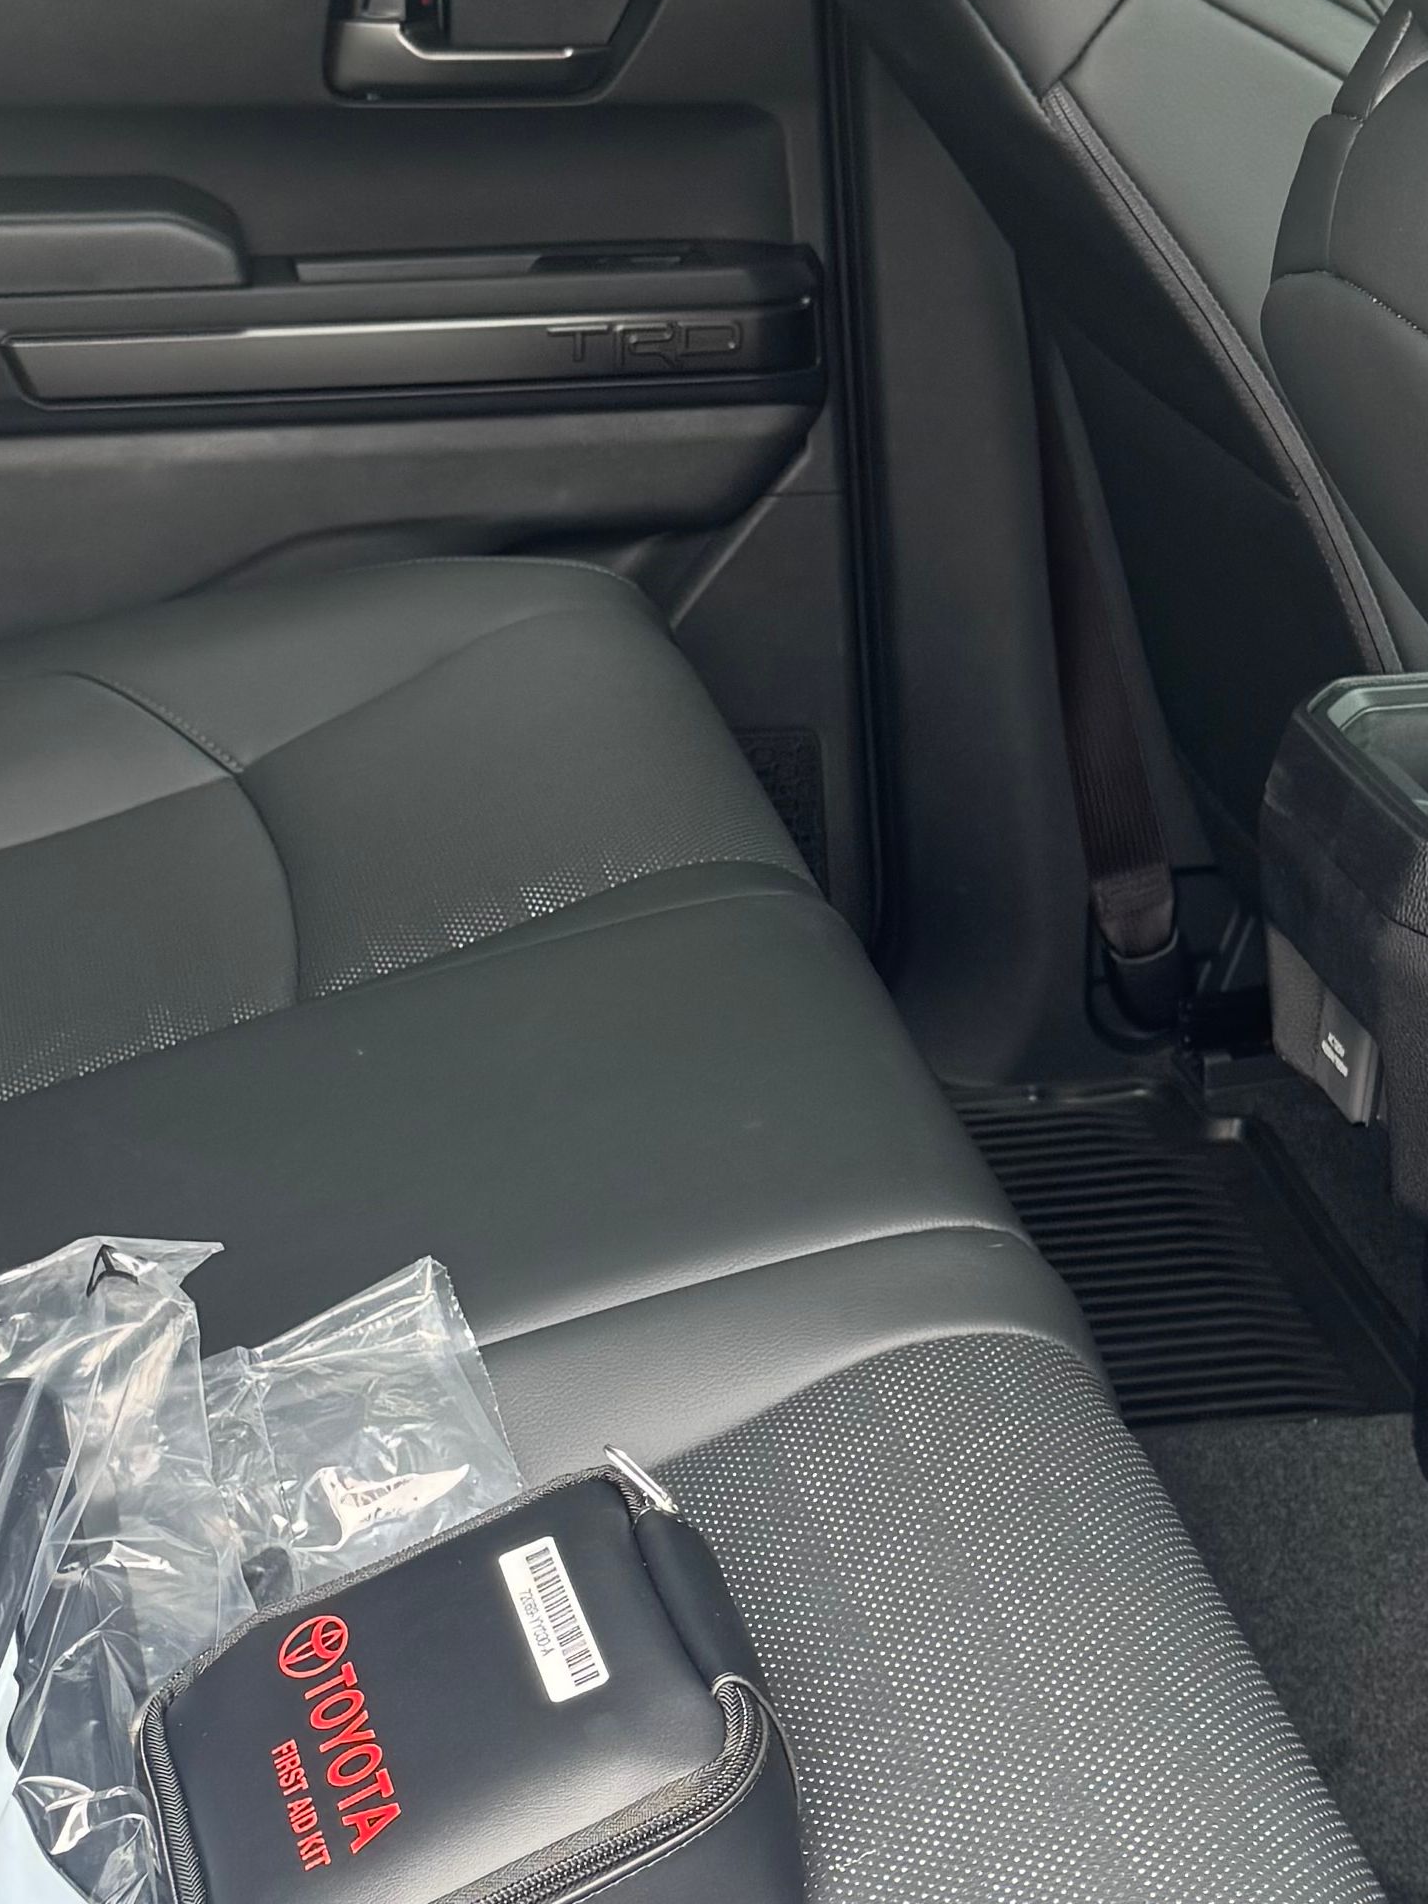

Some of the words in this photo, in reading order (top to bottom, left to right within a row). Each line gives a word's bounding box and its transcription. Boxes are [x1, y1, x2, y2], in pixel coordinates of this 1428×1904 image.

[547, 322, 743, 368] TRD
[271, 1739, 309, 1796] FIRST
[304, 1661, 401, 1854] TOYOTA
[287, 1797, 318, 1834] AID
[297, 1830, 331, 1871] KIT
